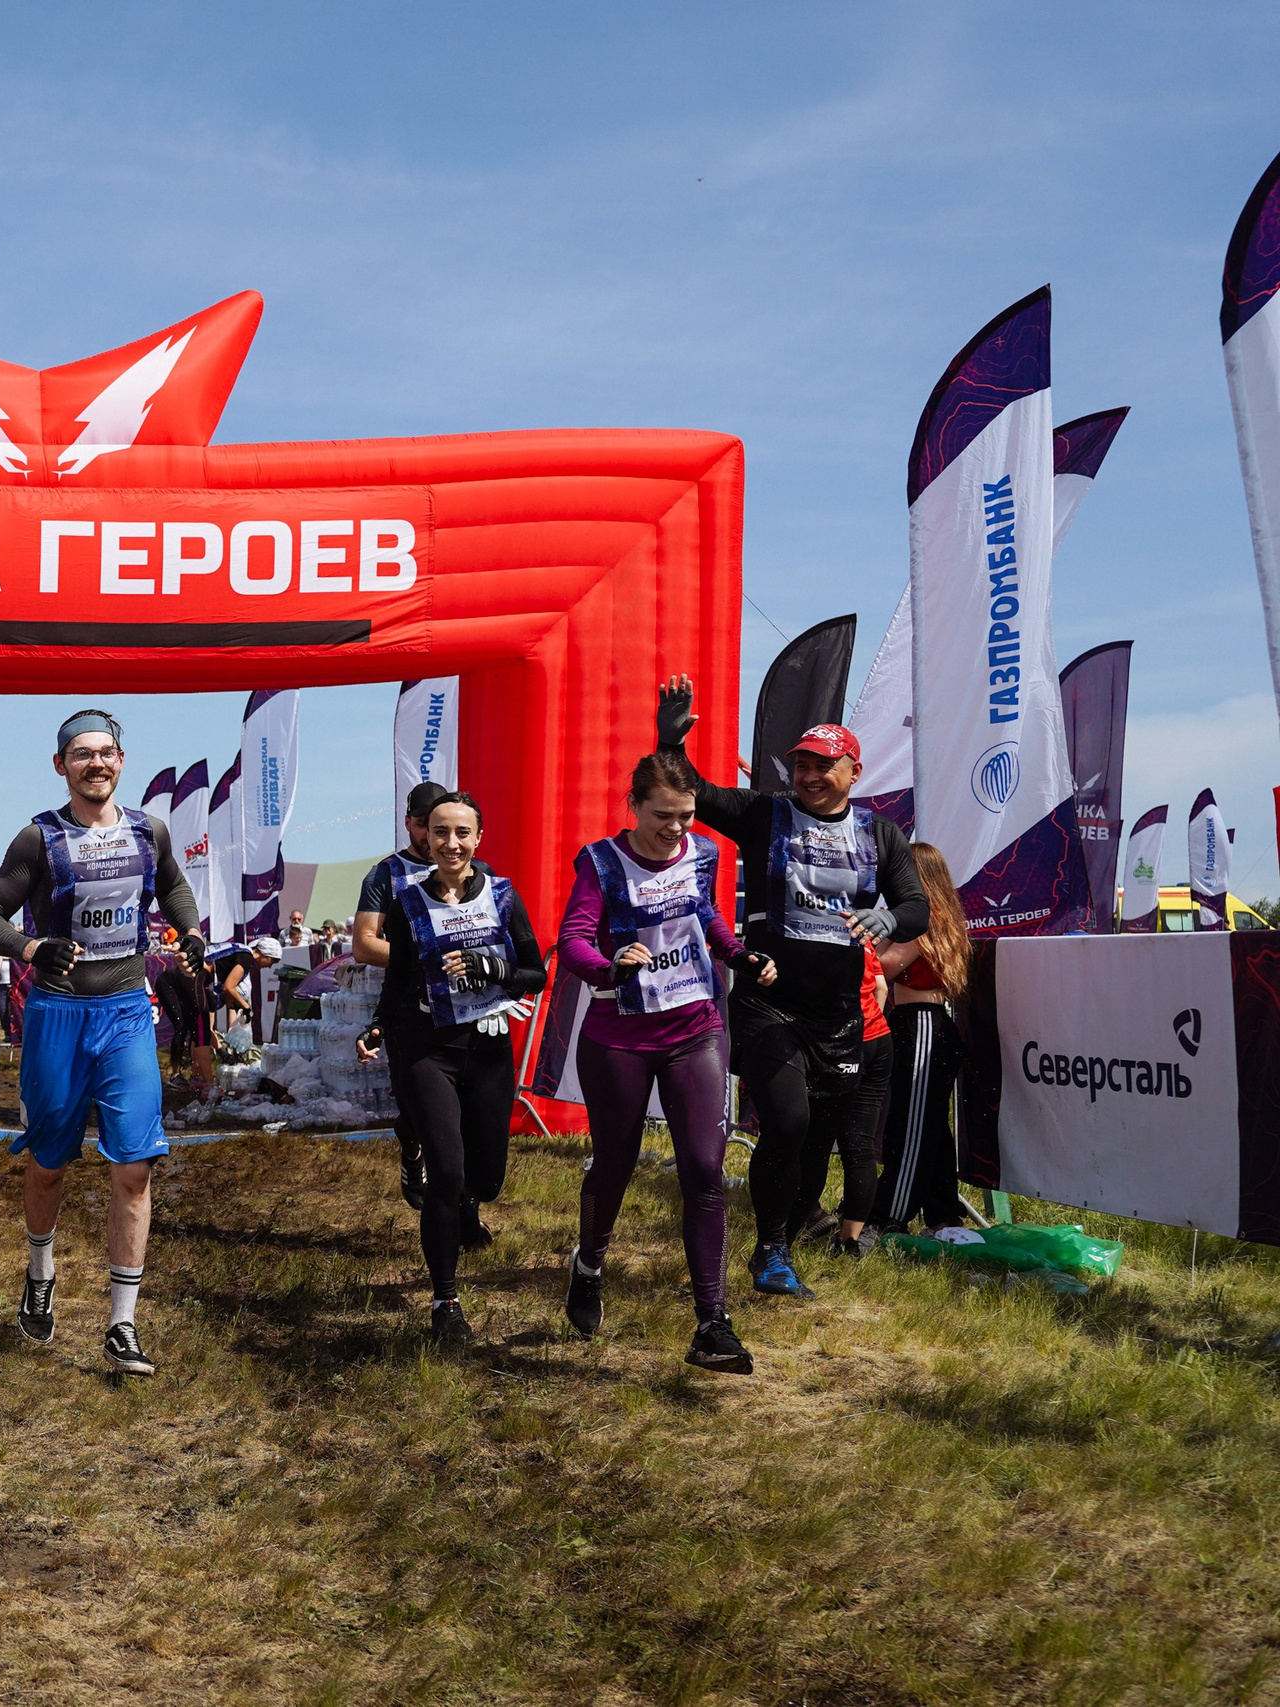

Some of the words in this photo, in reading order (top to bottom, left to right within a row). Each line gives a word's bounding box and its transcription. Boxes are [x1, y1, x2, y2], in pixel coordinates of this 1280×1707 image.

[39, 518, 417, 595] ГЕРОЕВ
[983, 474, 1020, 724] ГАЗПРОМБАНК
[261, 737, 270, 827] КОМСОМОЛЬСКАЯ
[268, 757, 281, 827] ПРАВДА
[86, 857, 130, 870] КОМАНДНЫЙ
[99, 868, 120, 878] СТАРТ
[80, 905, 134, 929] 08008
[964, 917, 997, 931] ОНКА
[1000, 907, 1051, 926] ГЕРОЕВ
[450, 928, 493, 943] КОМАНДНЫЙ
[463, 938, 483, 949] СТАРТ
[1022, 1040, 1192, 1104] Северсталь
